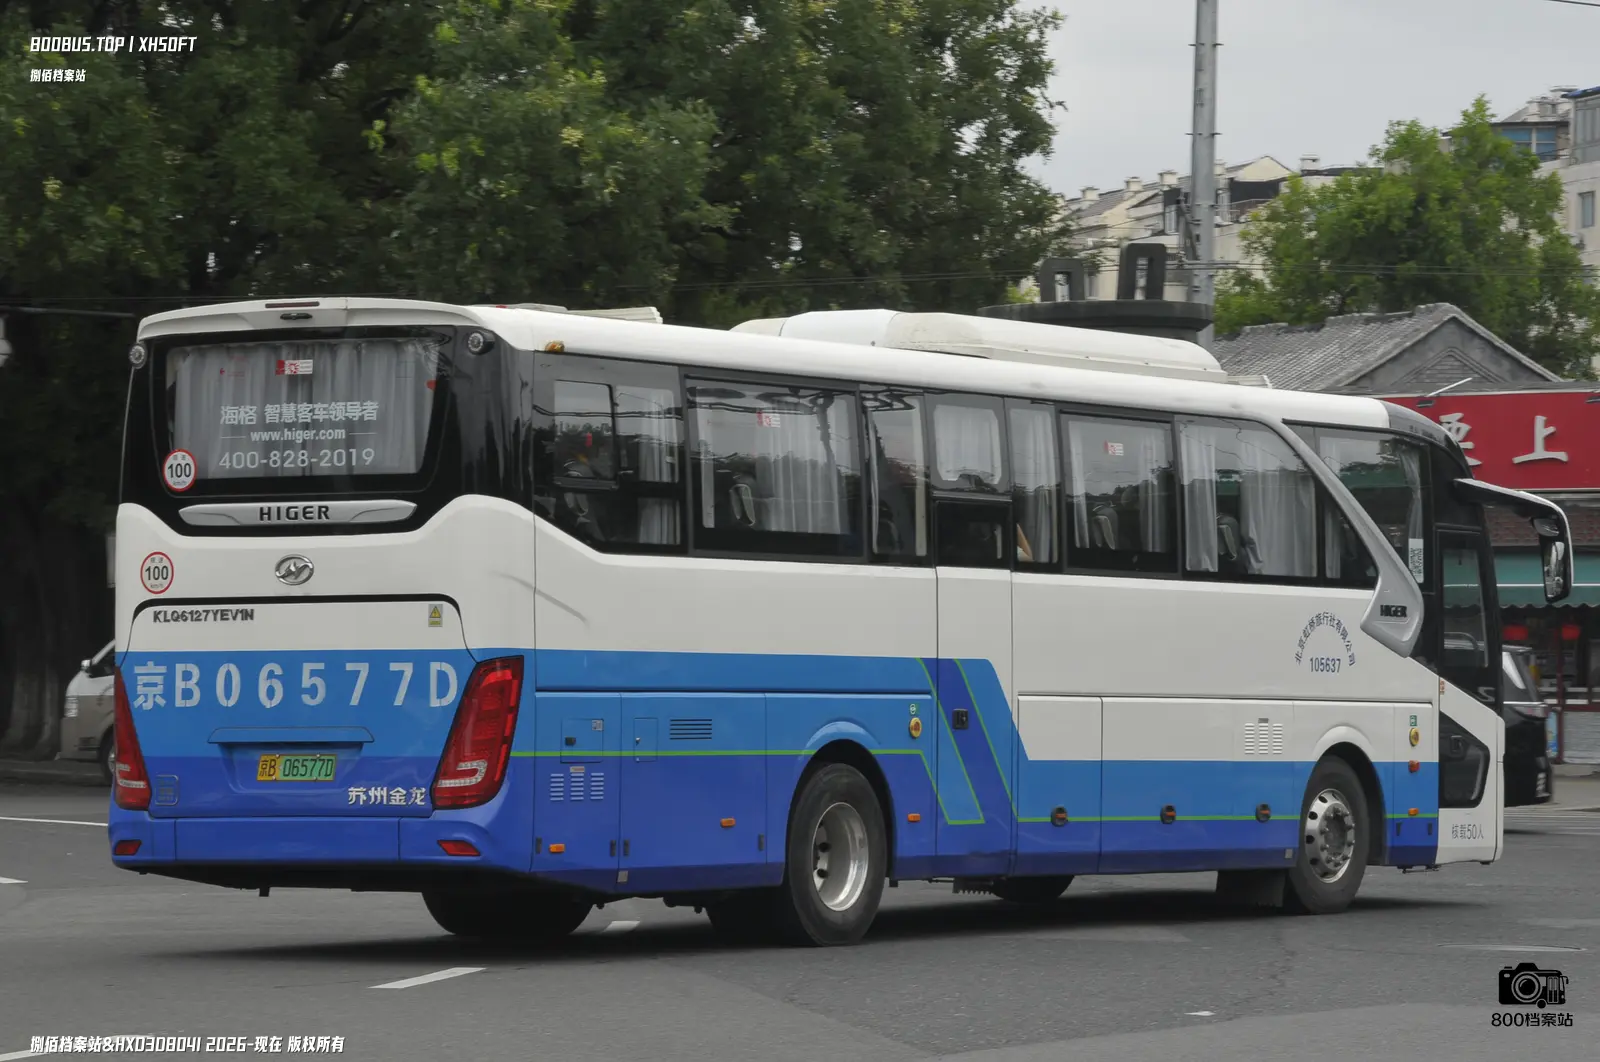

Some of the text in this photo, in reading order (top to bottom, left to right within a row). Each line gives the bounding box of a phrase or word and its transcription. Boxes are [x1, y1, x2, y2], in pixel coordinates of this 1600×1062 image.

[220, 401, 379, 425] 海格 智慧客车领导者
[250, 428, 346, 443] www.higer.com
[219, 448, 375, 469] 400-828-2019
[167, 462, 192, 478] 100
[259, 505, 331, 522] HIGER
[145, 565, 169, 581] 100
[153, 609, 254, 623] KLQ6127YEV1N
[1380, 604, 1408, 618] HIGER
[1309, 657, 1341, 673] 105637
[133, 661, 459, 711] 京B06577D
[348, 786, 427, 806] 苏州金龙
[1451, 824, 1484, 840] 核载50人
